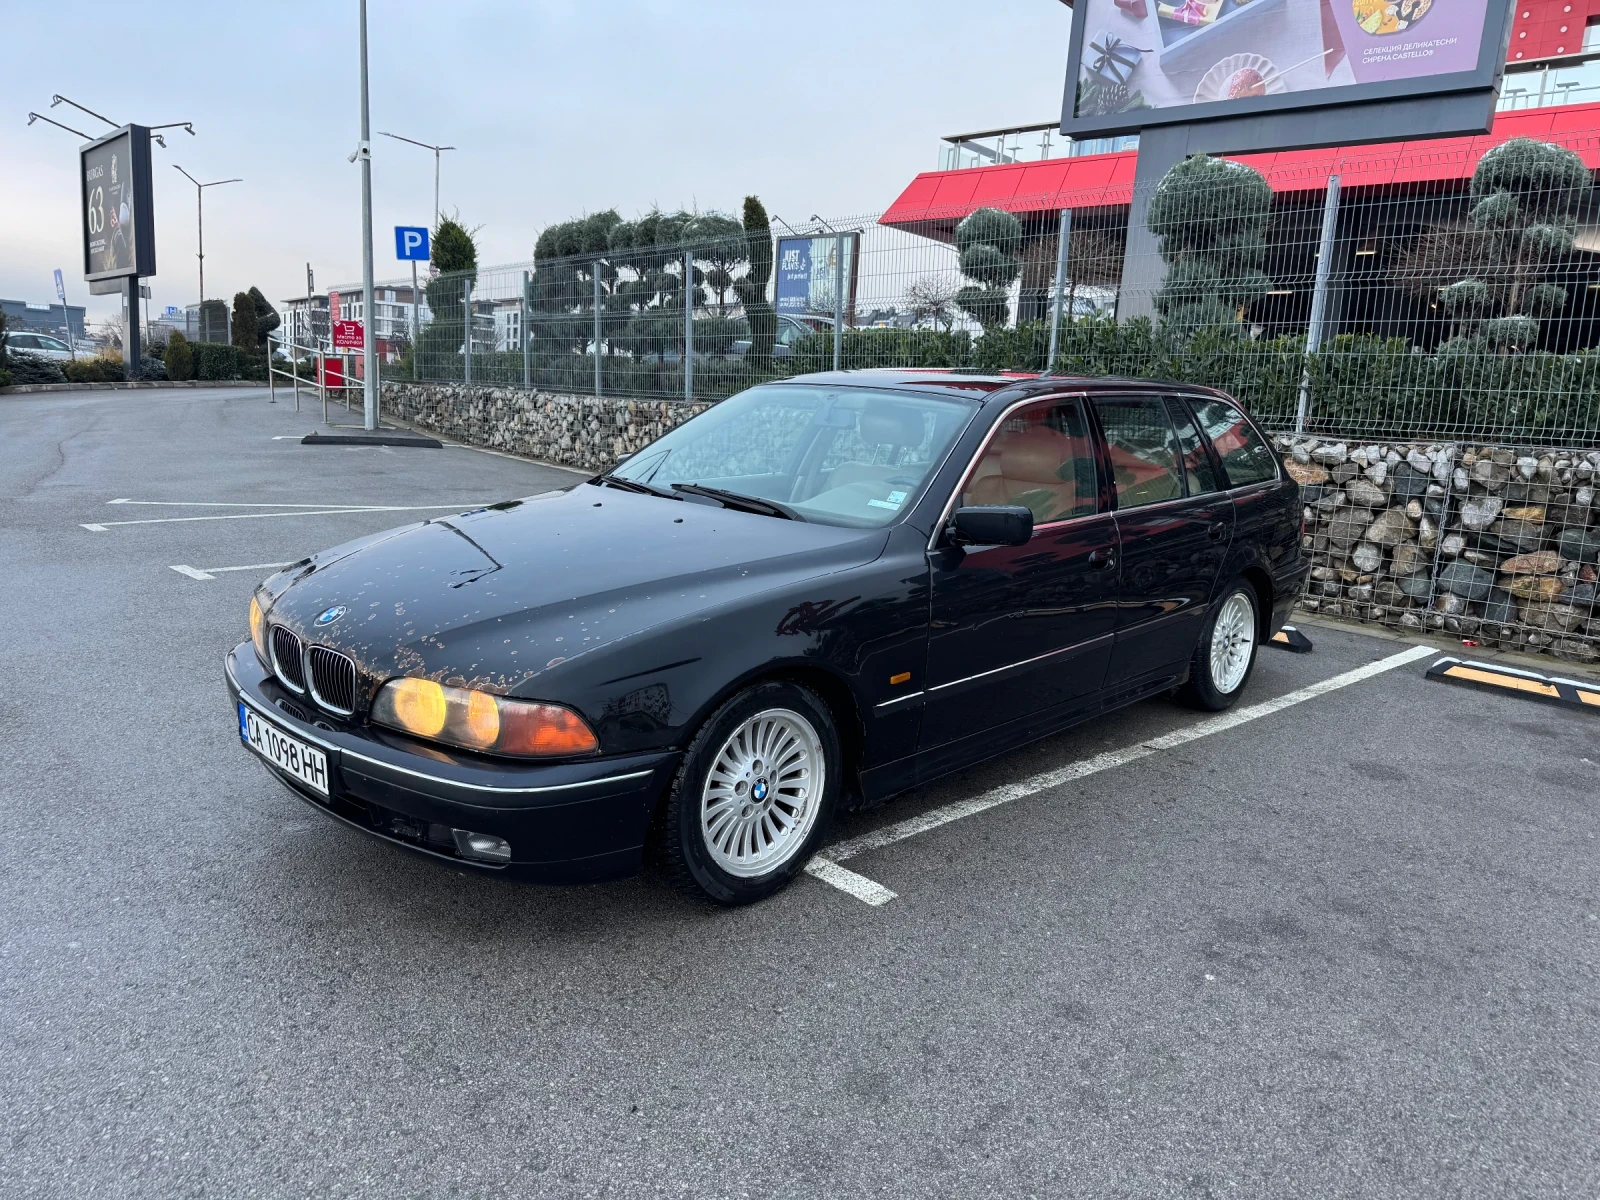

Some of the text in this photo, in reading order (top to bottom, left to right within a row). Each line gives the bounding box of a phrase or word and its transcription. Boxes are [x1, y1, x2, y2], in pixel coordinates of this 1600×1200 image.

[1363, 37, 1458, 55] СЕЛЕКЦИЯ ДЕЛИКАТЕСНИ
[1362, 54, 1392, 64] СИРЕНА
[88, 186, 105, 235] 63
[403, 230, 423, 256] P
[784, 249, 800, 262] JUST
[265, 728, 300, 773] 1098
[301, 747, 326, 789] HH
